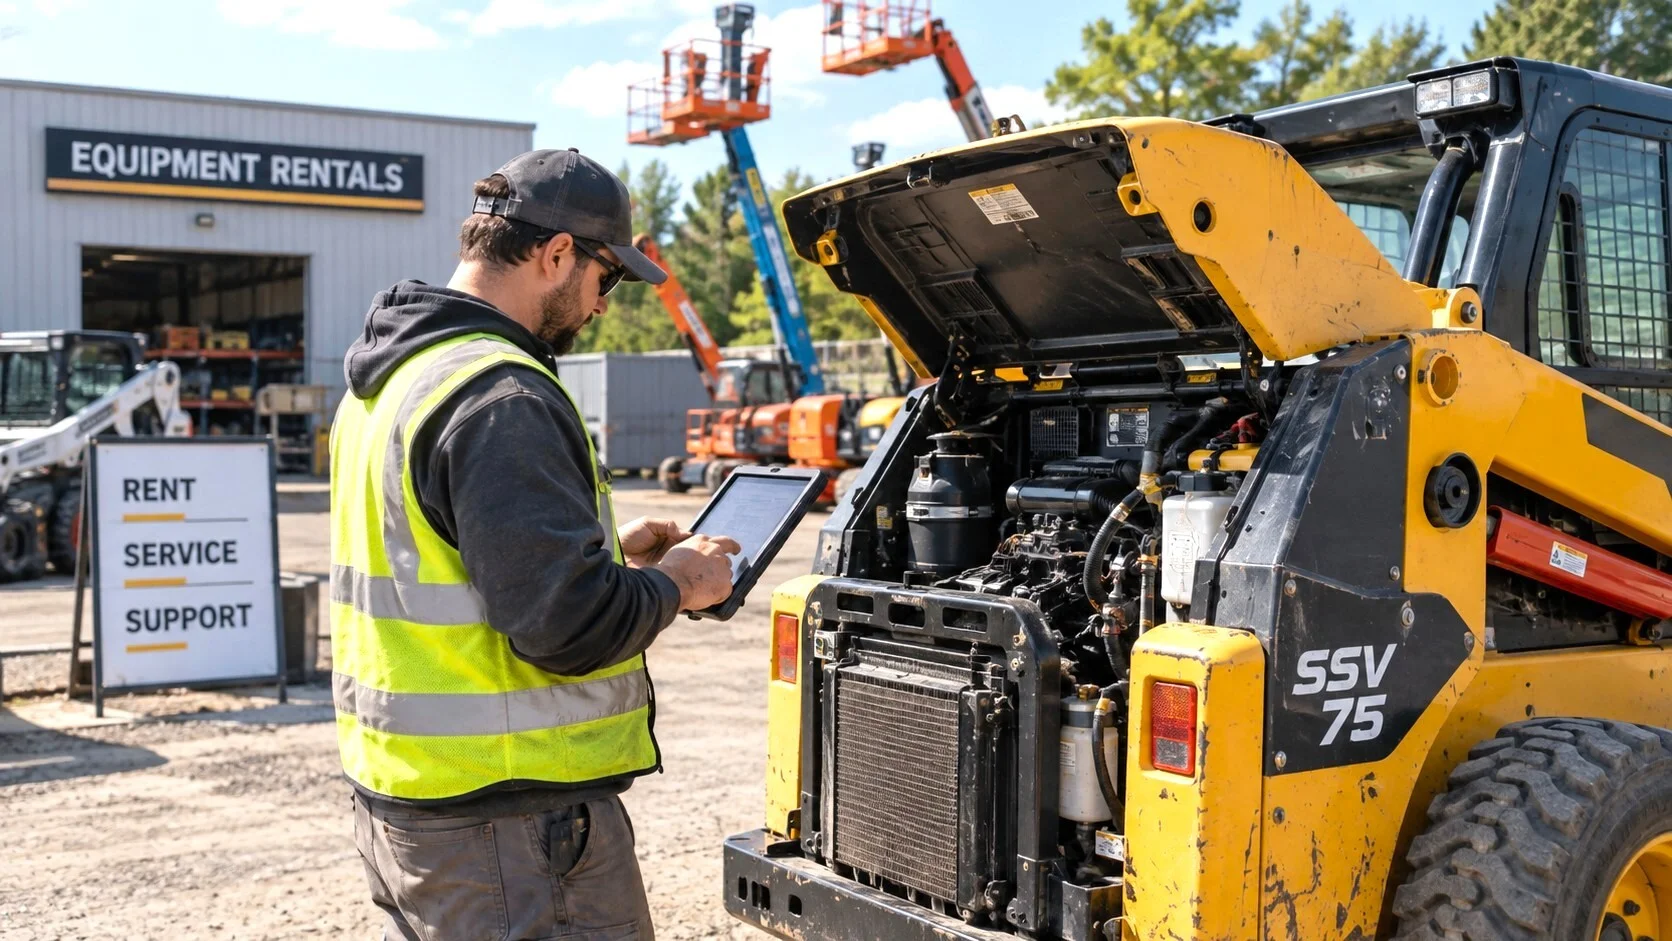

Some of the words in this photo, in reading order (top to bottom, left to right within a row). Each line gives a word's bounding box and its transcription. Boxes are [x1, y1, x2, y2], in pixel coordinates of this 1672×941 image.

[71, 141, 261, 182] EQUIPMENT
[271, 155, 403, 192] RENTALS
[123, 477, 197, 502] RENT
[124, 540, 238, 568] SERVICE
[125, 603, 253, 634] SUPPORT
[1292, 643, 1399, 696] SSV
[1319, 693, 1388, 746] 75
